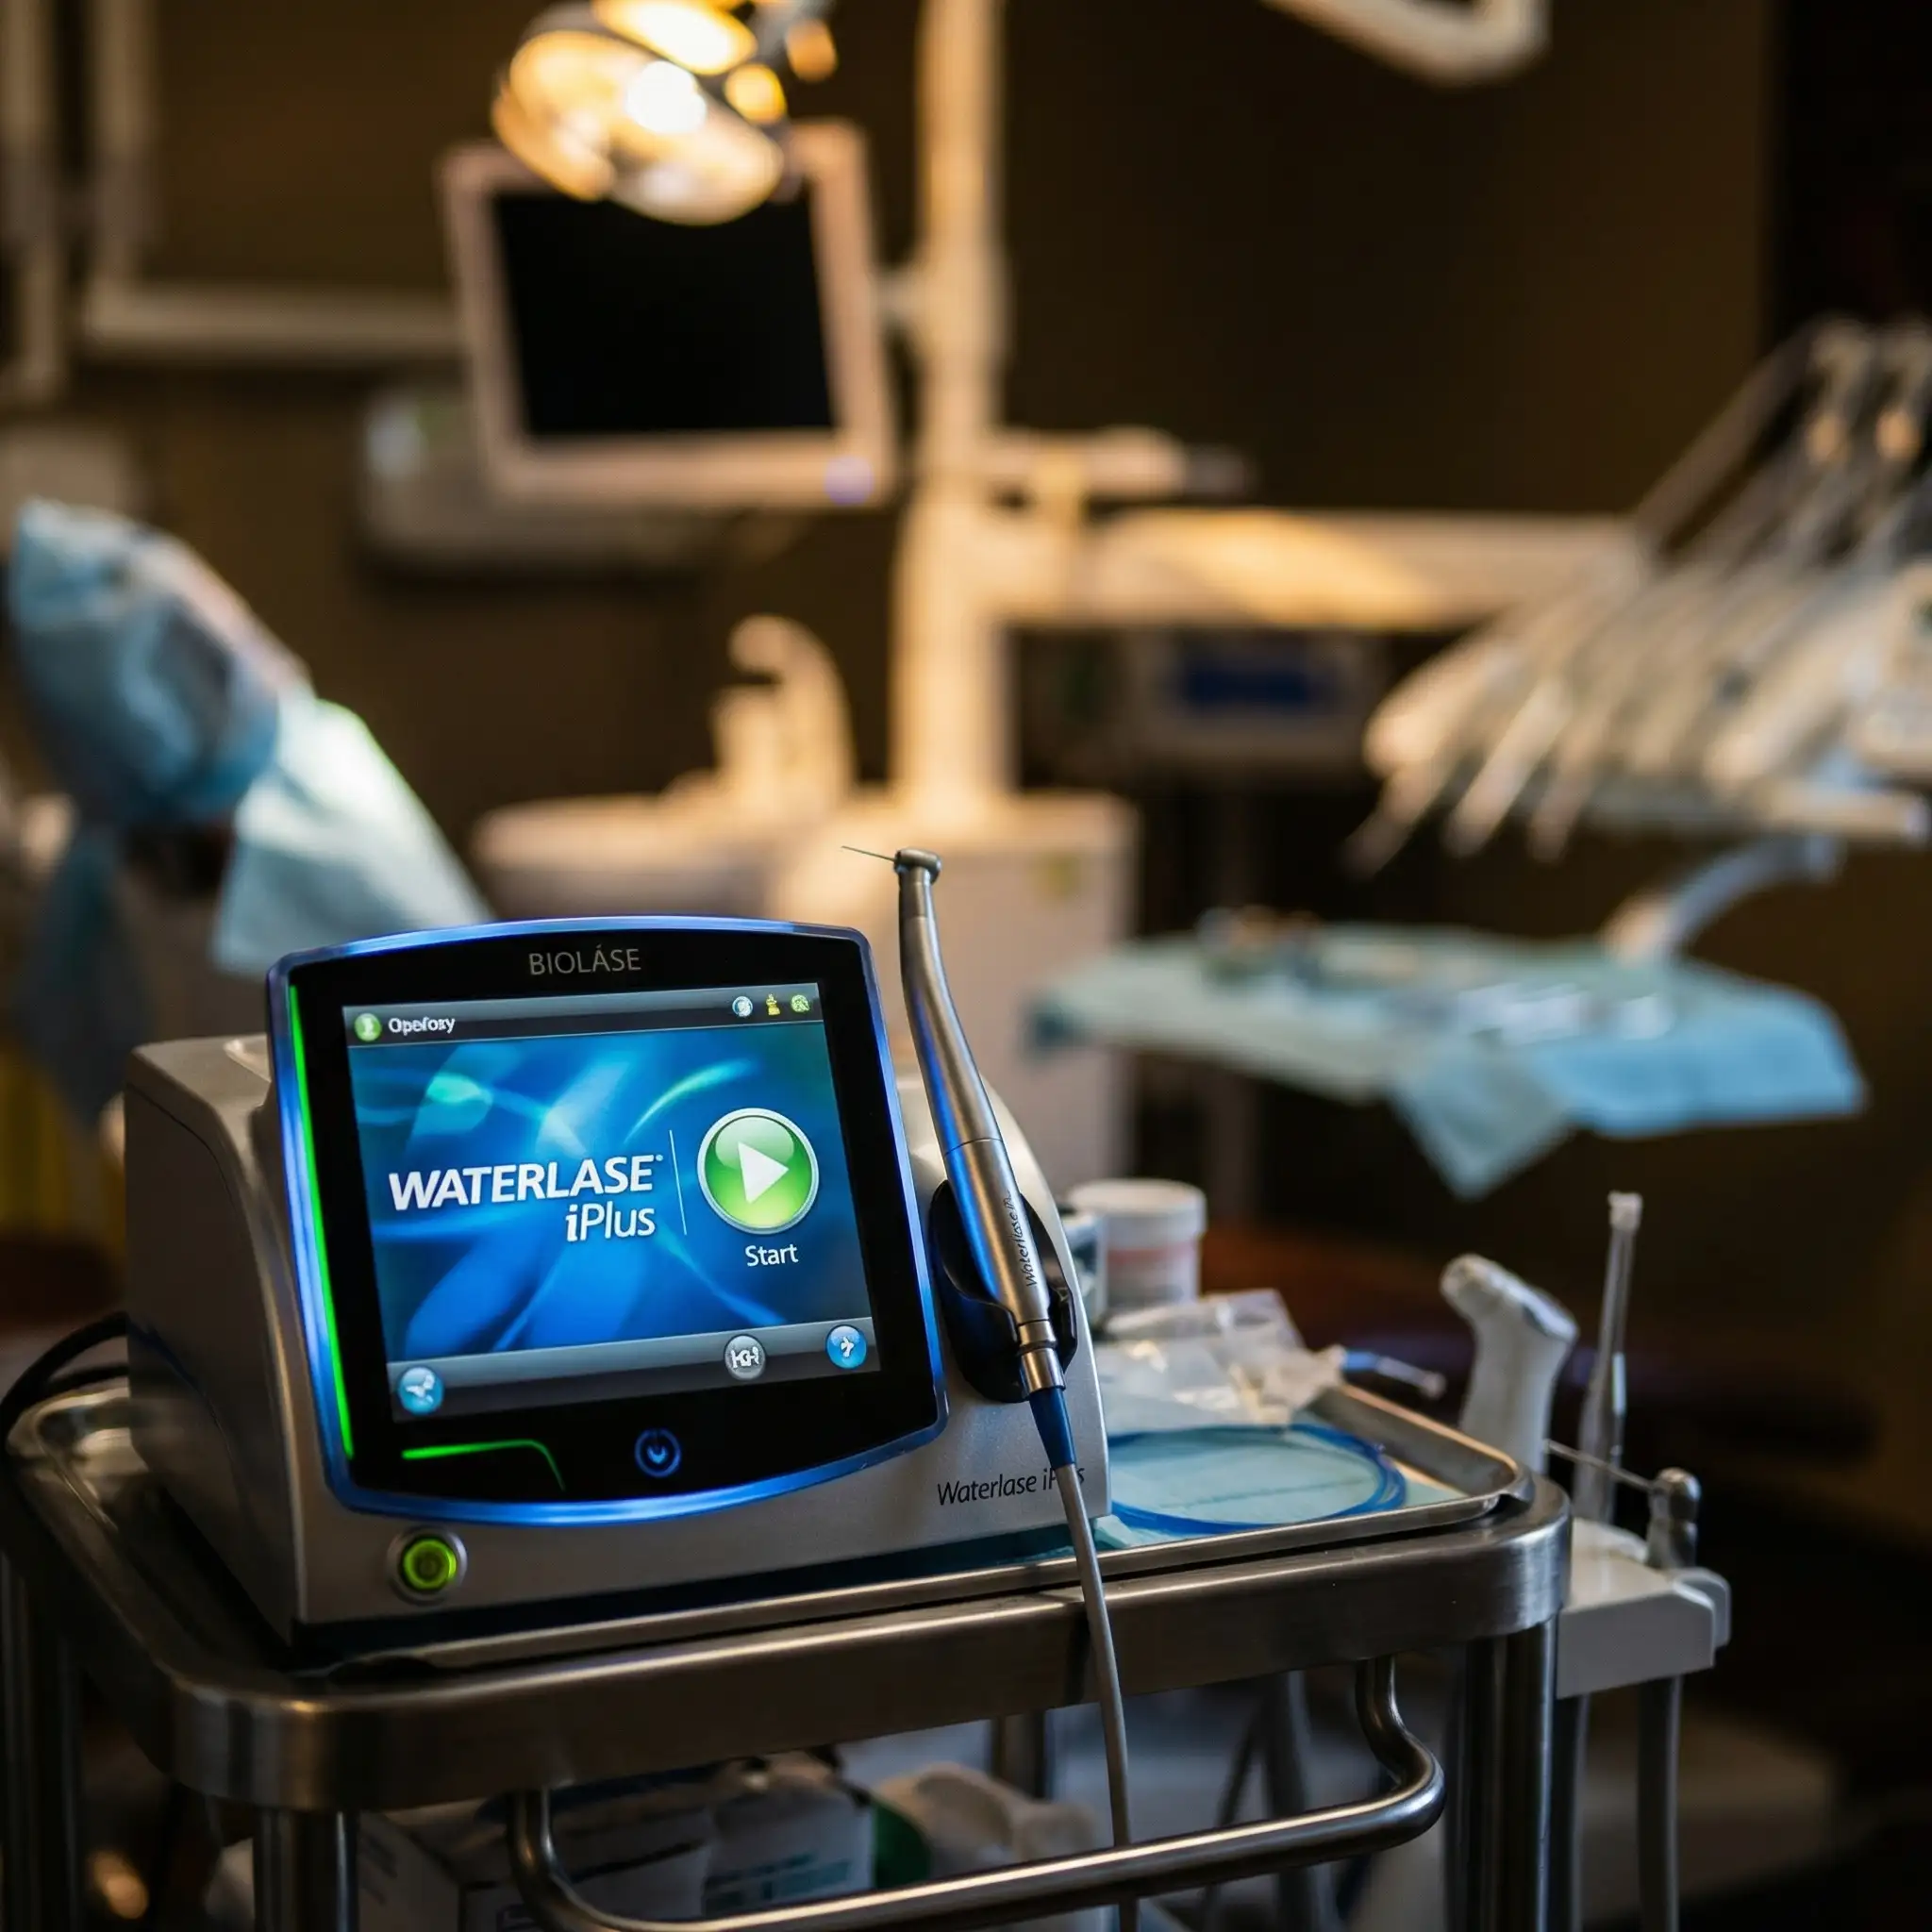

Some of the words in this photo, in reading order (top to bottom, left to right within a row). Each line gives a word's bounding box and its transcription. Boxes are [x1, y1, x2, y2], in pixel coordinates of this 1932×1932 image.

[388, 1154, 655, 1211] WATERLASE
[565, 1200, 657, 1242] iPlus
[744, 1243, 799, 1267] Start
[937, 1473, 1037, 1507] Waterlase
[1042, 1467, 1086, 1491] iPs
